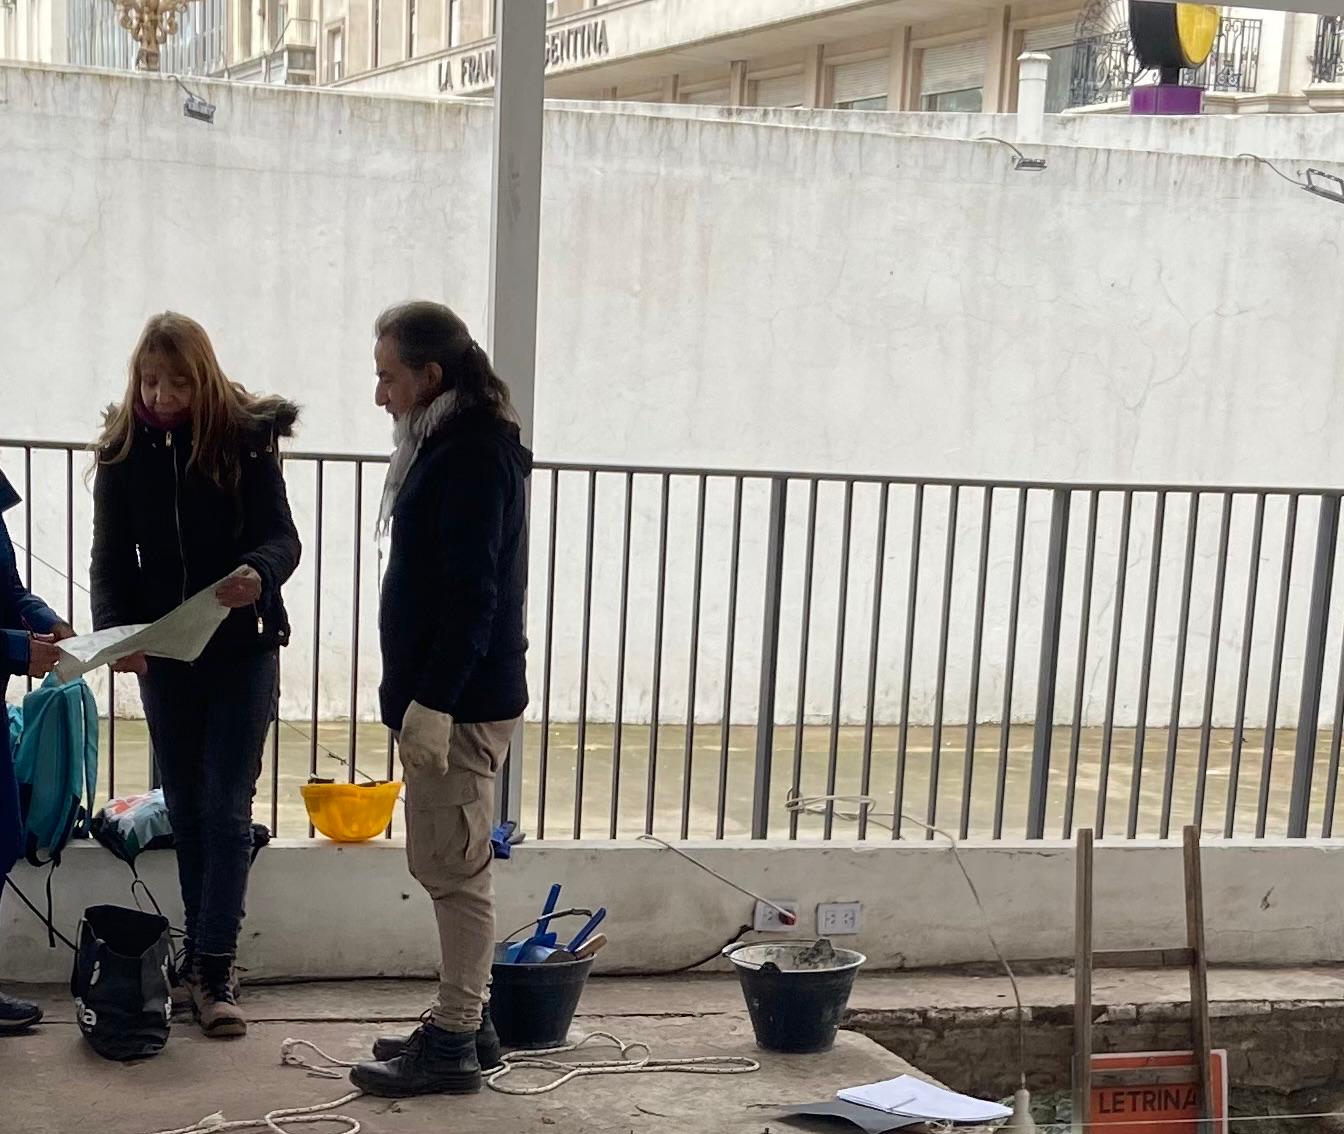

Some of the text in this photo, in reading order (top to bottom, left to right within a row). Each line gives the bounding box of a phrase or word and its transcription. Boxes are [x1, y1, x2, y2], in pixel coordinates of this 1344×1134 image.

[438, 20, 610, 92] LA FRAN GENTINA
[1098, 1088, 1199, 1115] LETRINA
